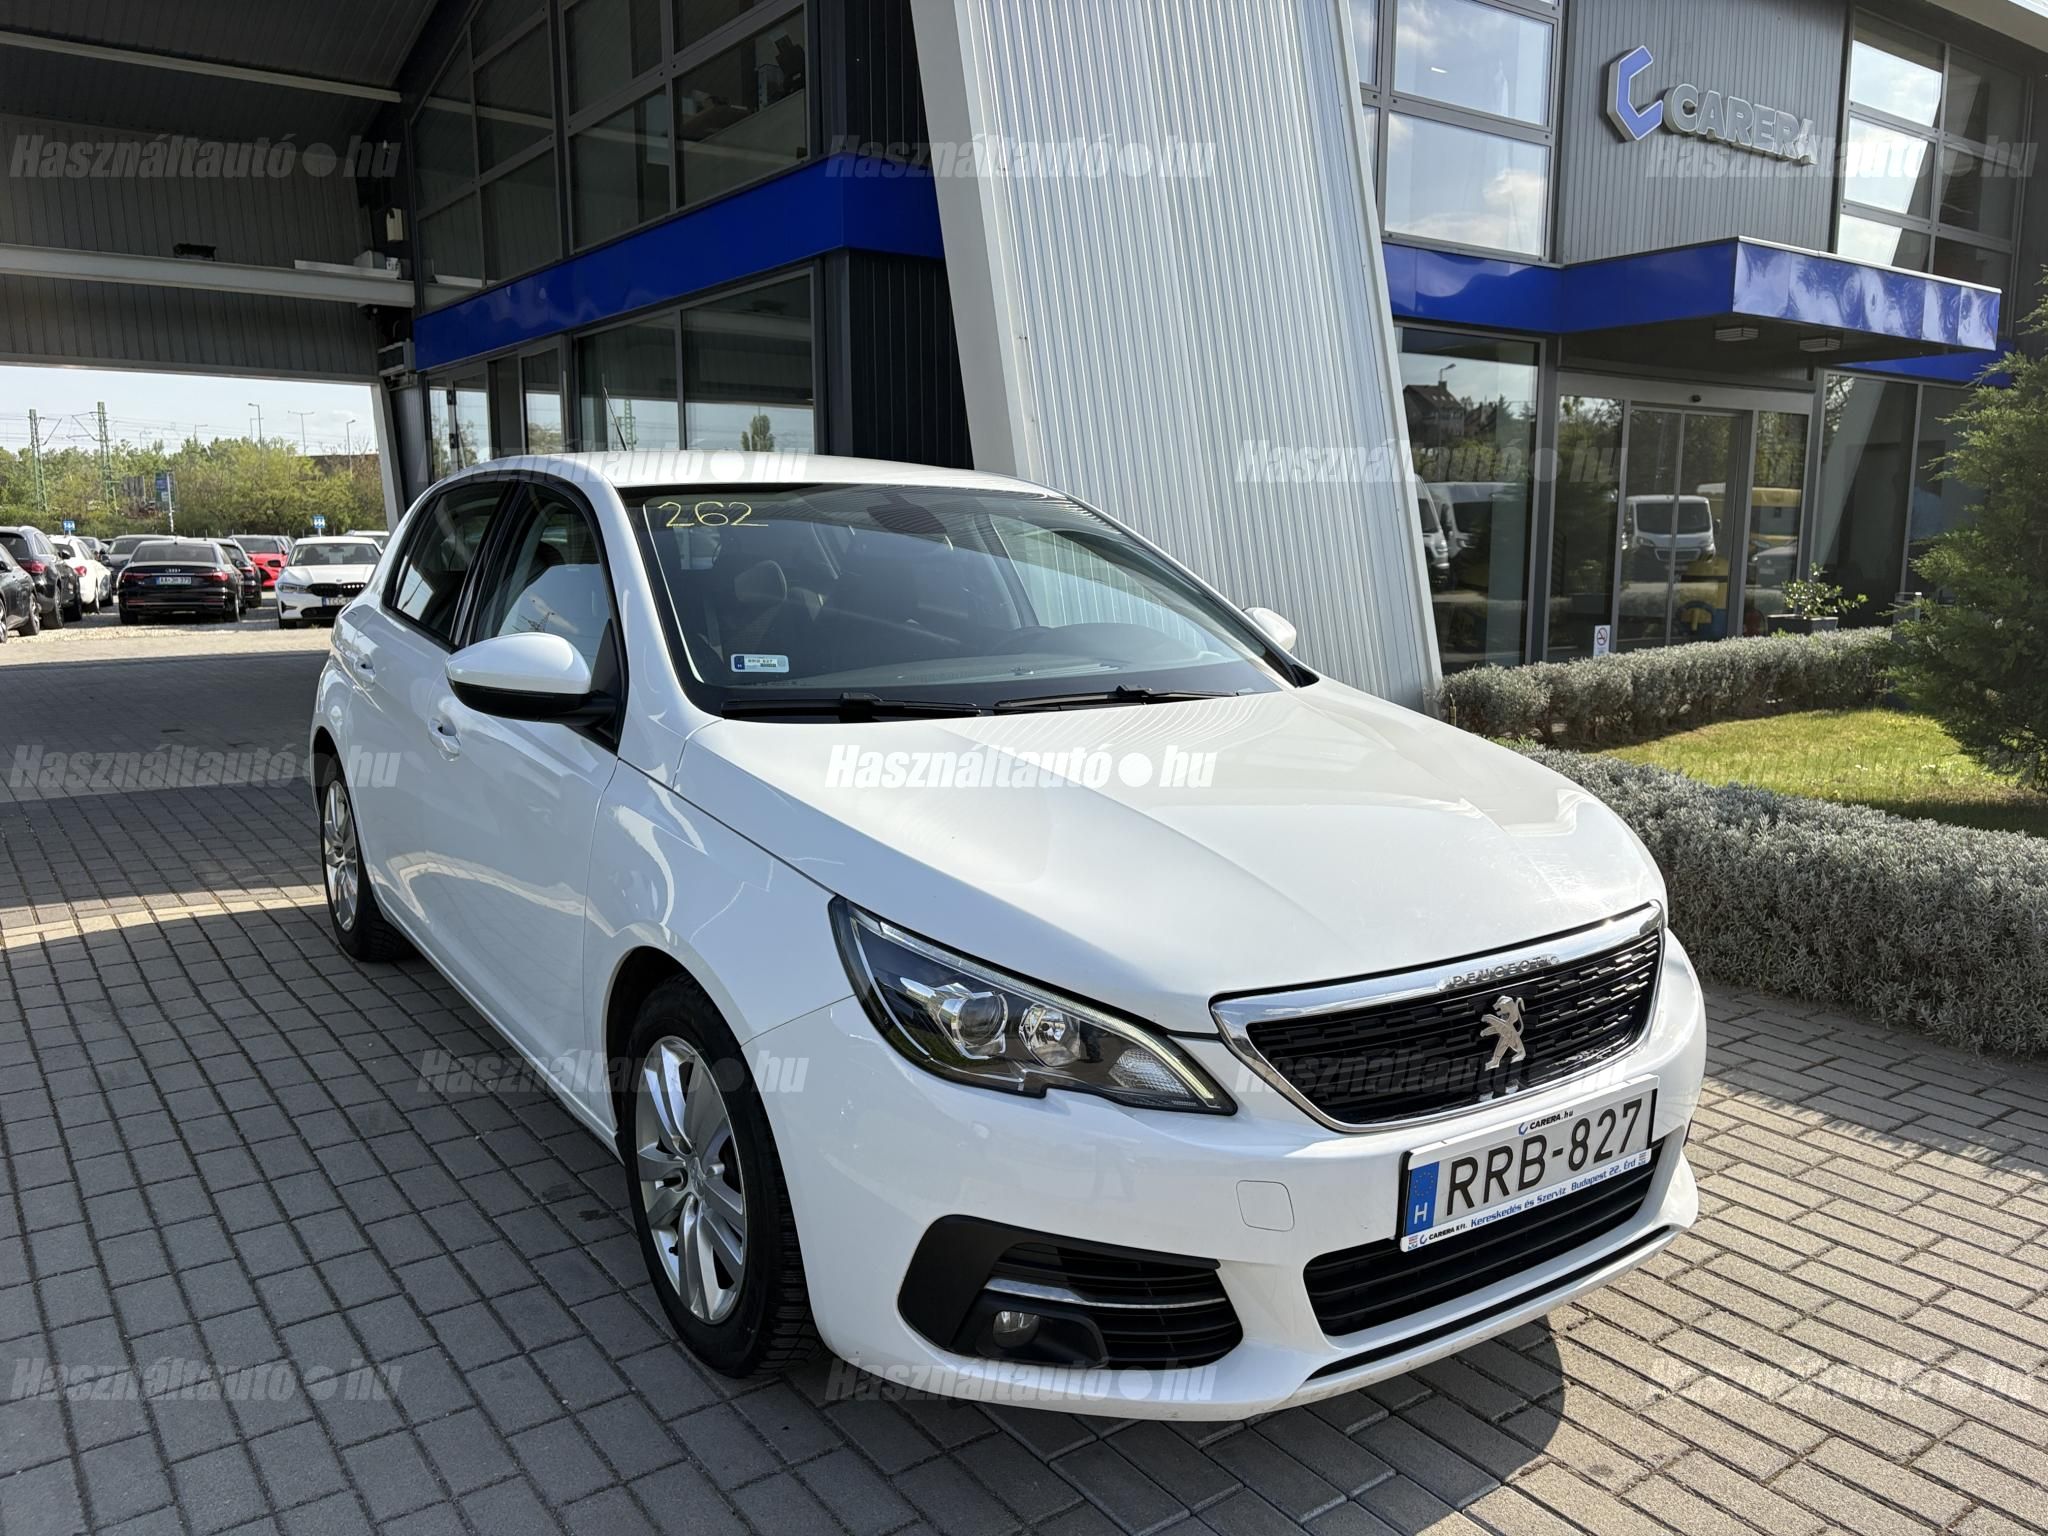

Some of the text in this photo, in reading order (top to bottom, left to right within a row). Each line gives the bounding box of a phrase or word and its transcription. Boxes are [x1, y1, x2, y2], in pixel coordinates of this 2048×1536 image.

[1663, 83, 1818, 166] CARERA
[658, 501, 768, 528] 262
[1414, 1098, 1643, 1225] H RRB-827
[1529, 1110, 1574, 1130] CARERA.hu
[1428, 1228, 1455, 1240] CARERA
[1471, 1204, 1522, 1228] Kereskedés
[1524, 1199, 1535, 1209] és
[1571, 1171, 1607, 1191] Budapest
[1624, 1157, 1636, 1170] Érd
